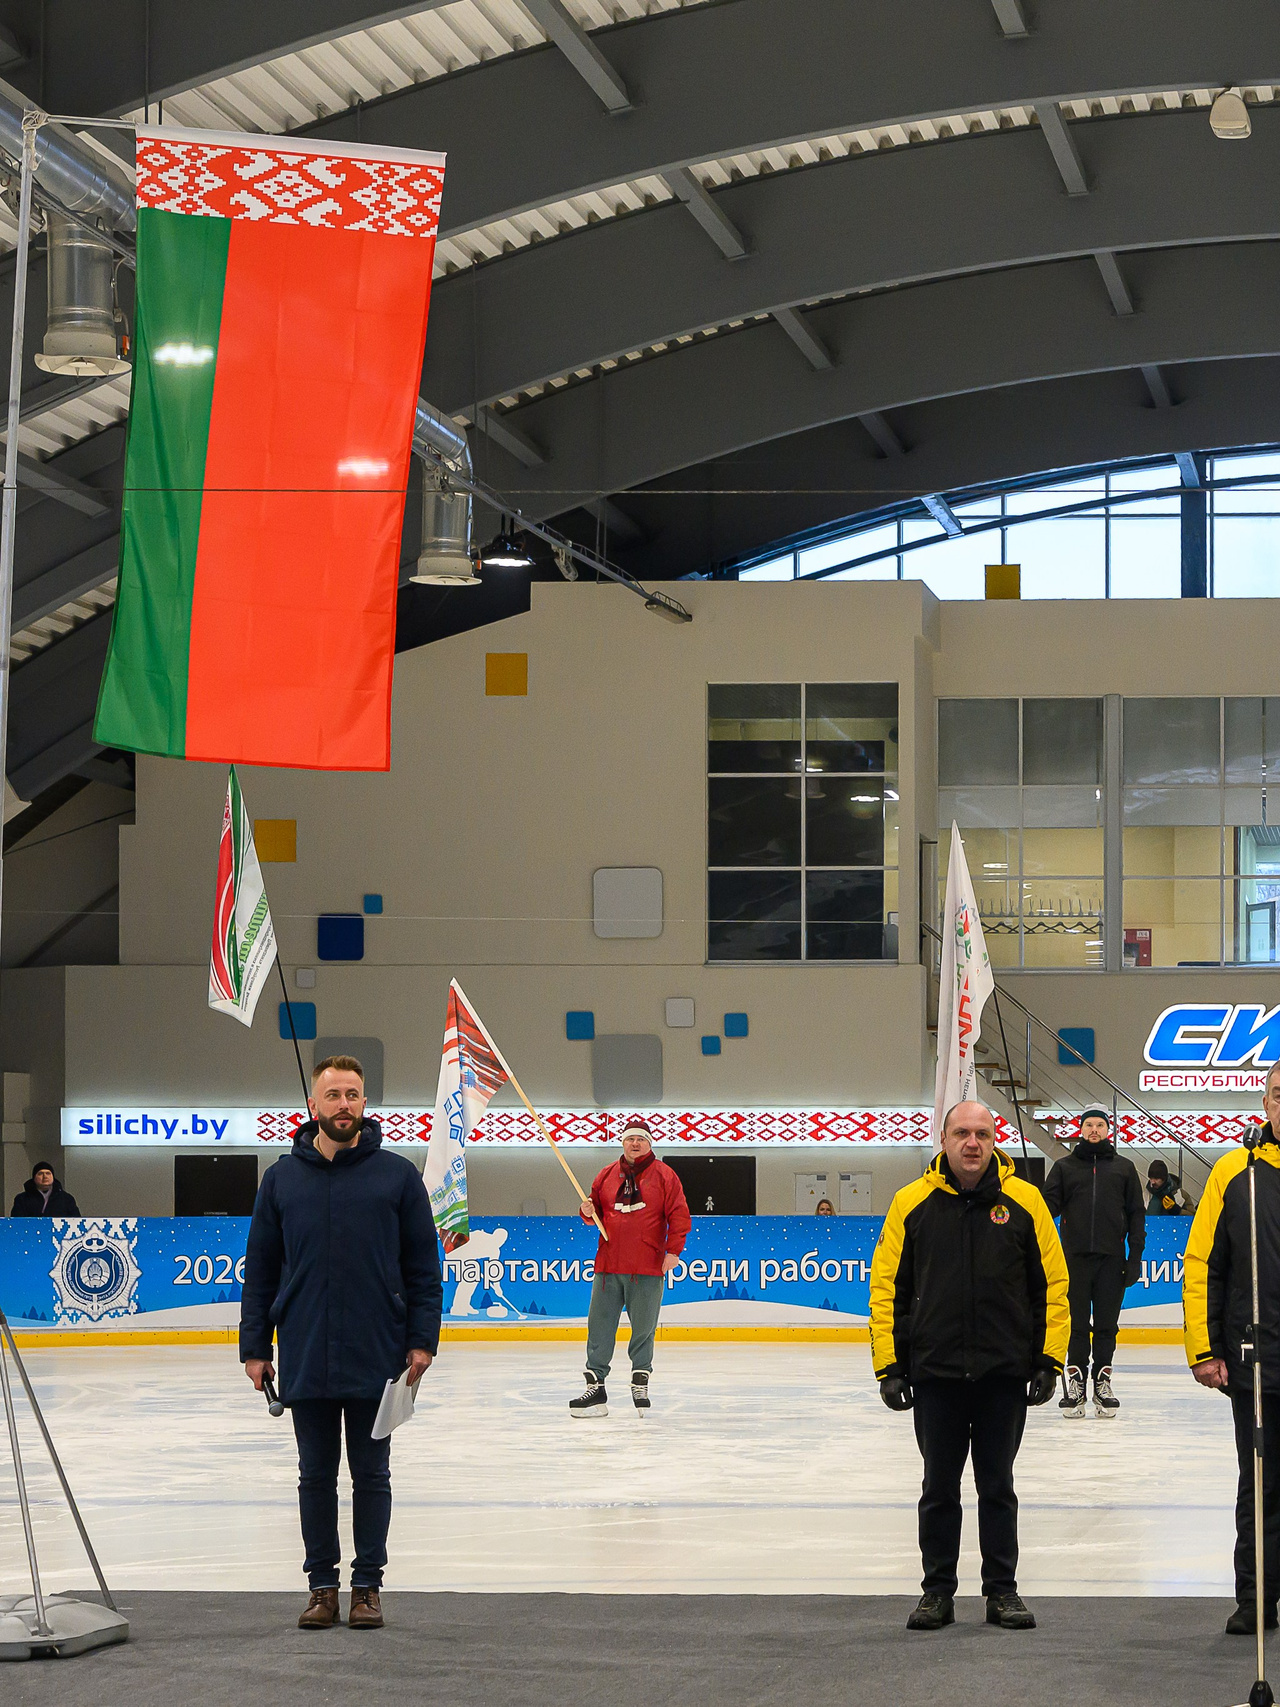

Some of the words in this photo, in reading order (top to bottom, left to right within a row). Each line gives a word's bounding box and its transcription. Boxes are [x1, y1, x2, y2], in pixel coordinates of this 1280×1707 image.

[78, 1113, 230, 1140] silichy.by
[442, 1259, 596, 1290] партакиа
[664, 1258, 750, 1290] реди
[759, 1250, 872, 1290] работн
